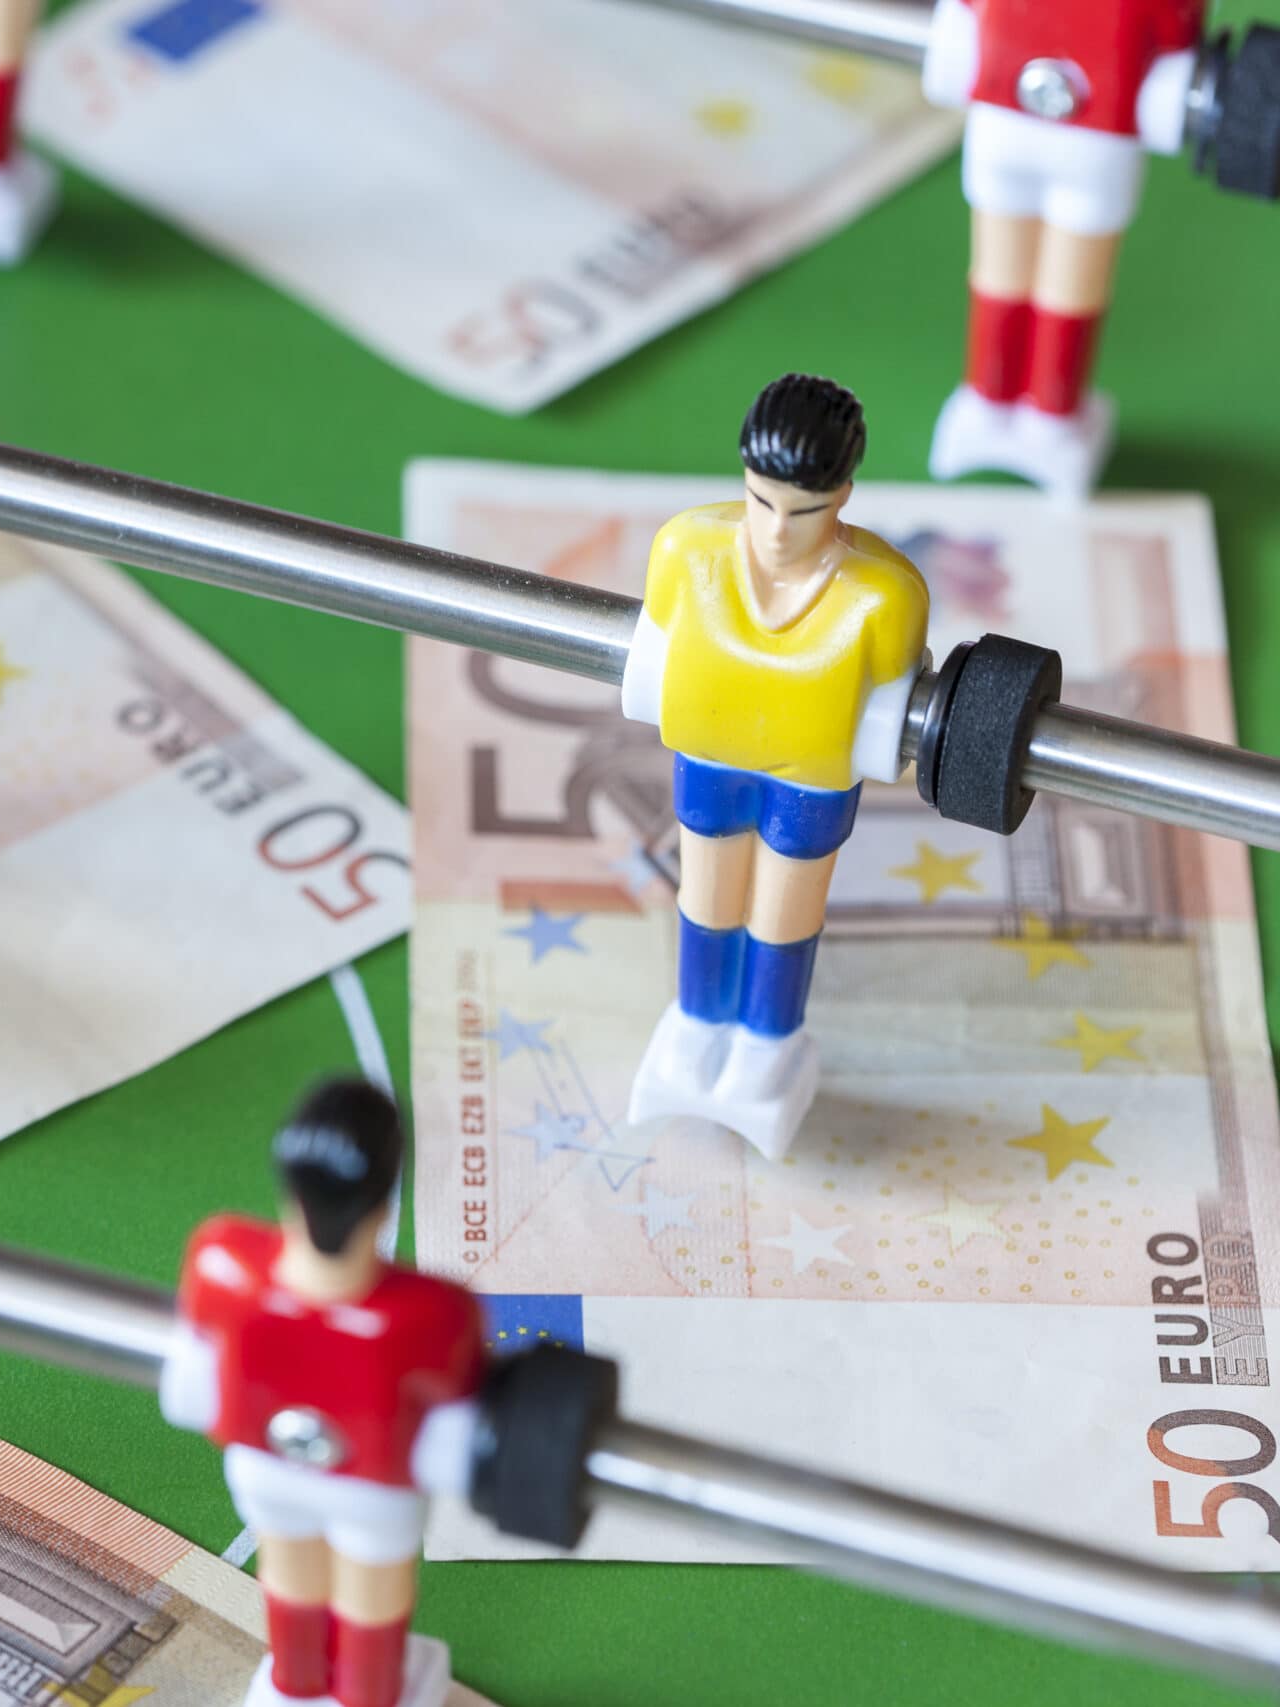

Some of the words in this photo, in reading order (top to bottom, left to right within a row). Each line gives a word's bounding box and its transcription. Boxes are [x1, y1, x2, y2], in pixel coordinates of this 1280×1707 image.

[115, 697, 266, 818] EURO
[256, 802, 414, 924] 50
[460, 1093, 487, 1137] EZB
[462, 1144, 488, 1189] ECB
[463, 1199, 489, 1244] BCE
[1144, 1231, 1214, 1385] EURO
[1147, 1409, 1280, 1545] 50
